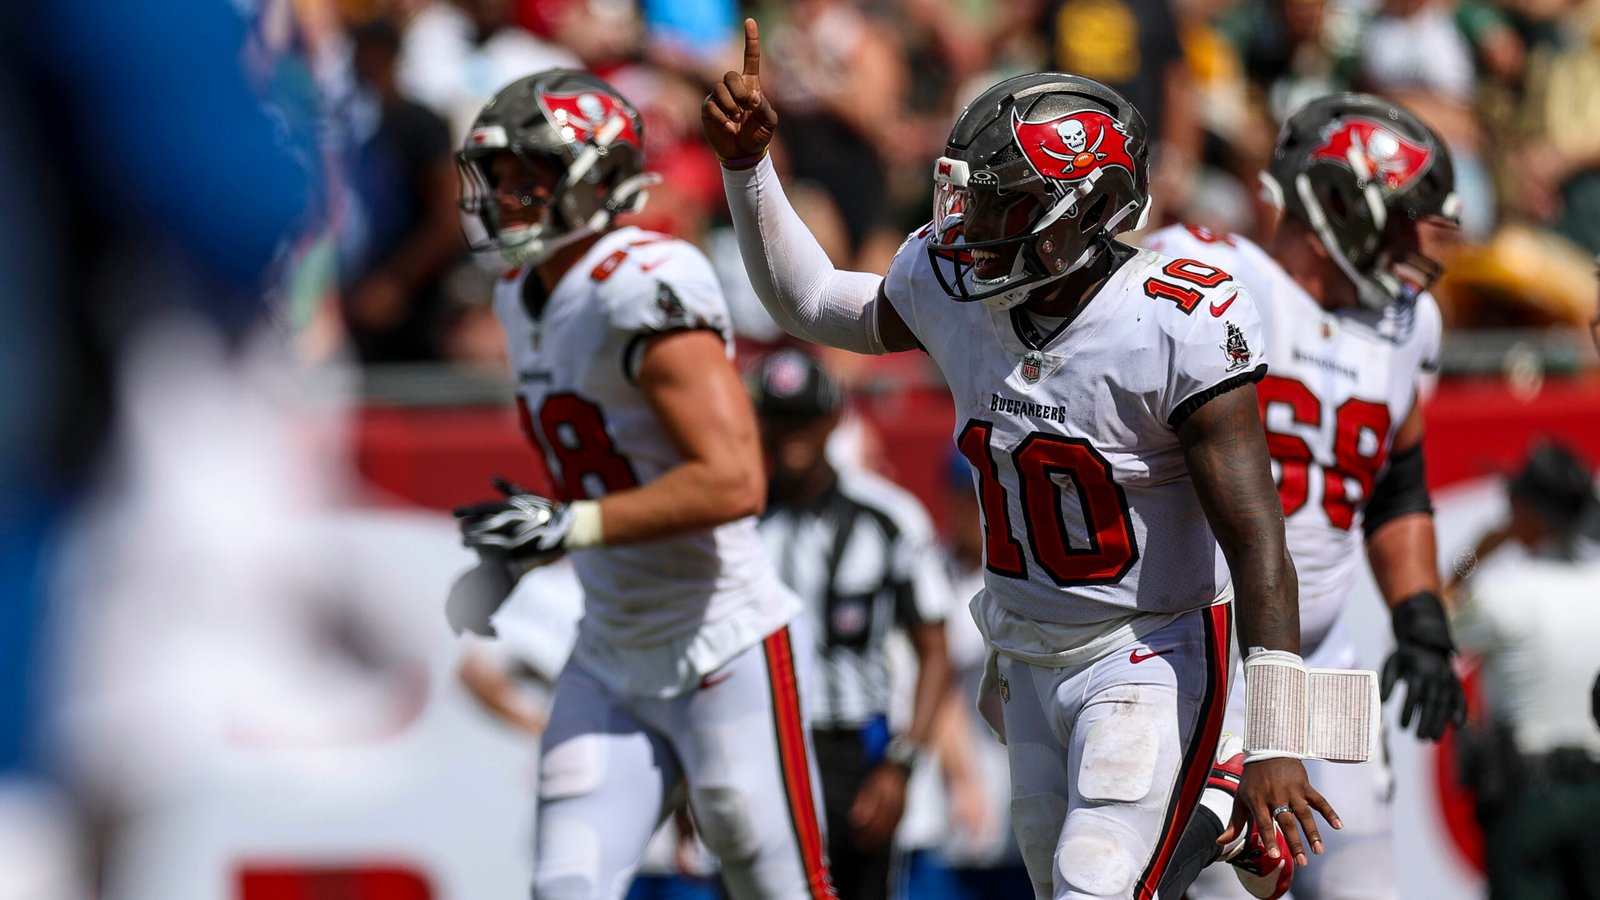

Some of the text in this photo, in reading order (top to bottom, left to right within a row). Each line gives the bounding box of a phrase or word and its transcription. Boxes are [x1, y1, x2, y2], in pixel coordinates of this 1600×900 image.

[1143, 258, 1233, 316] 10
[517, 392, 638, 499] 8
[991, 393, 1066, 424] BUCCANEERS
[1254, 375, 1391, 530] 68
[957, 419, 1140, 587] 10
